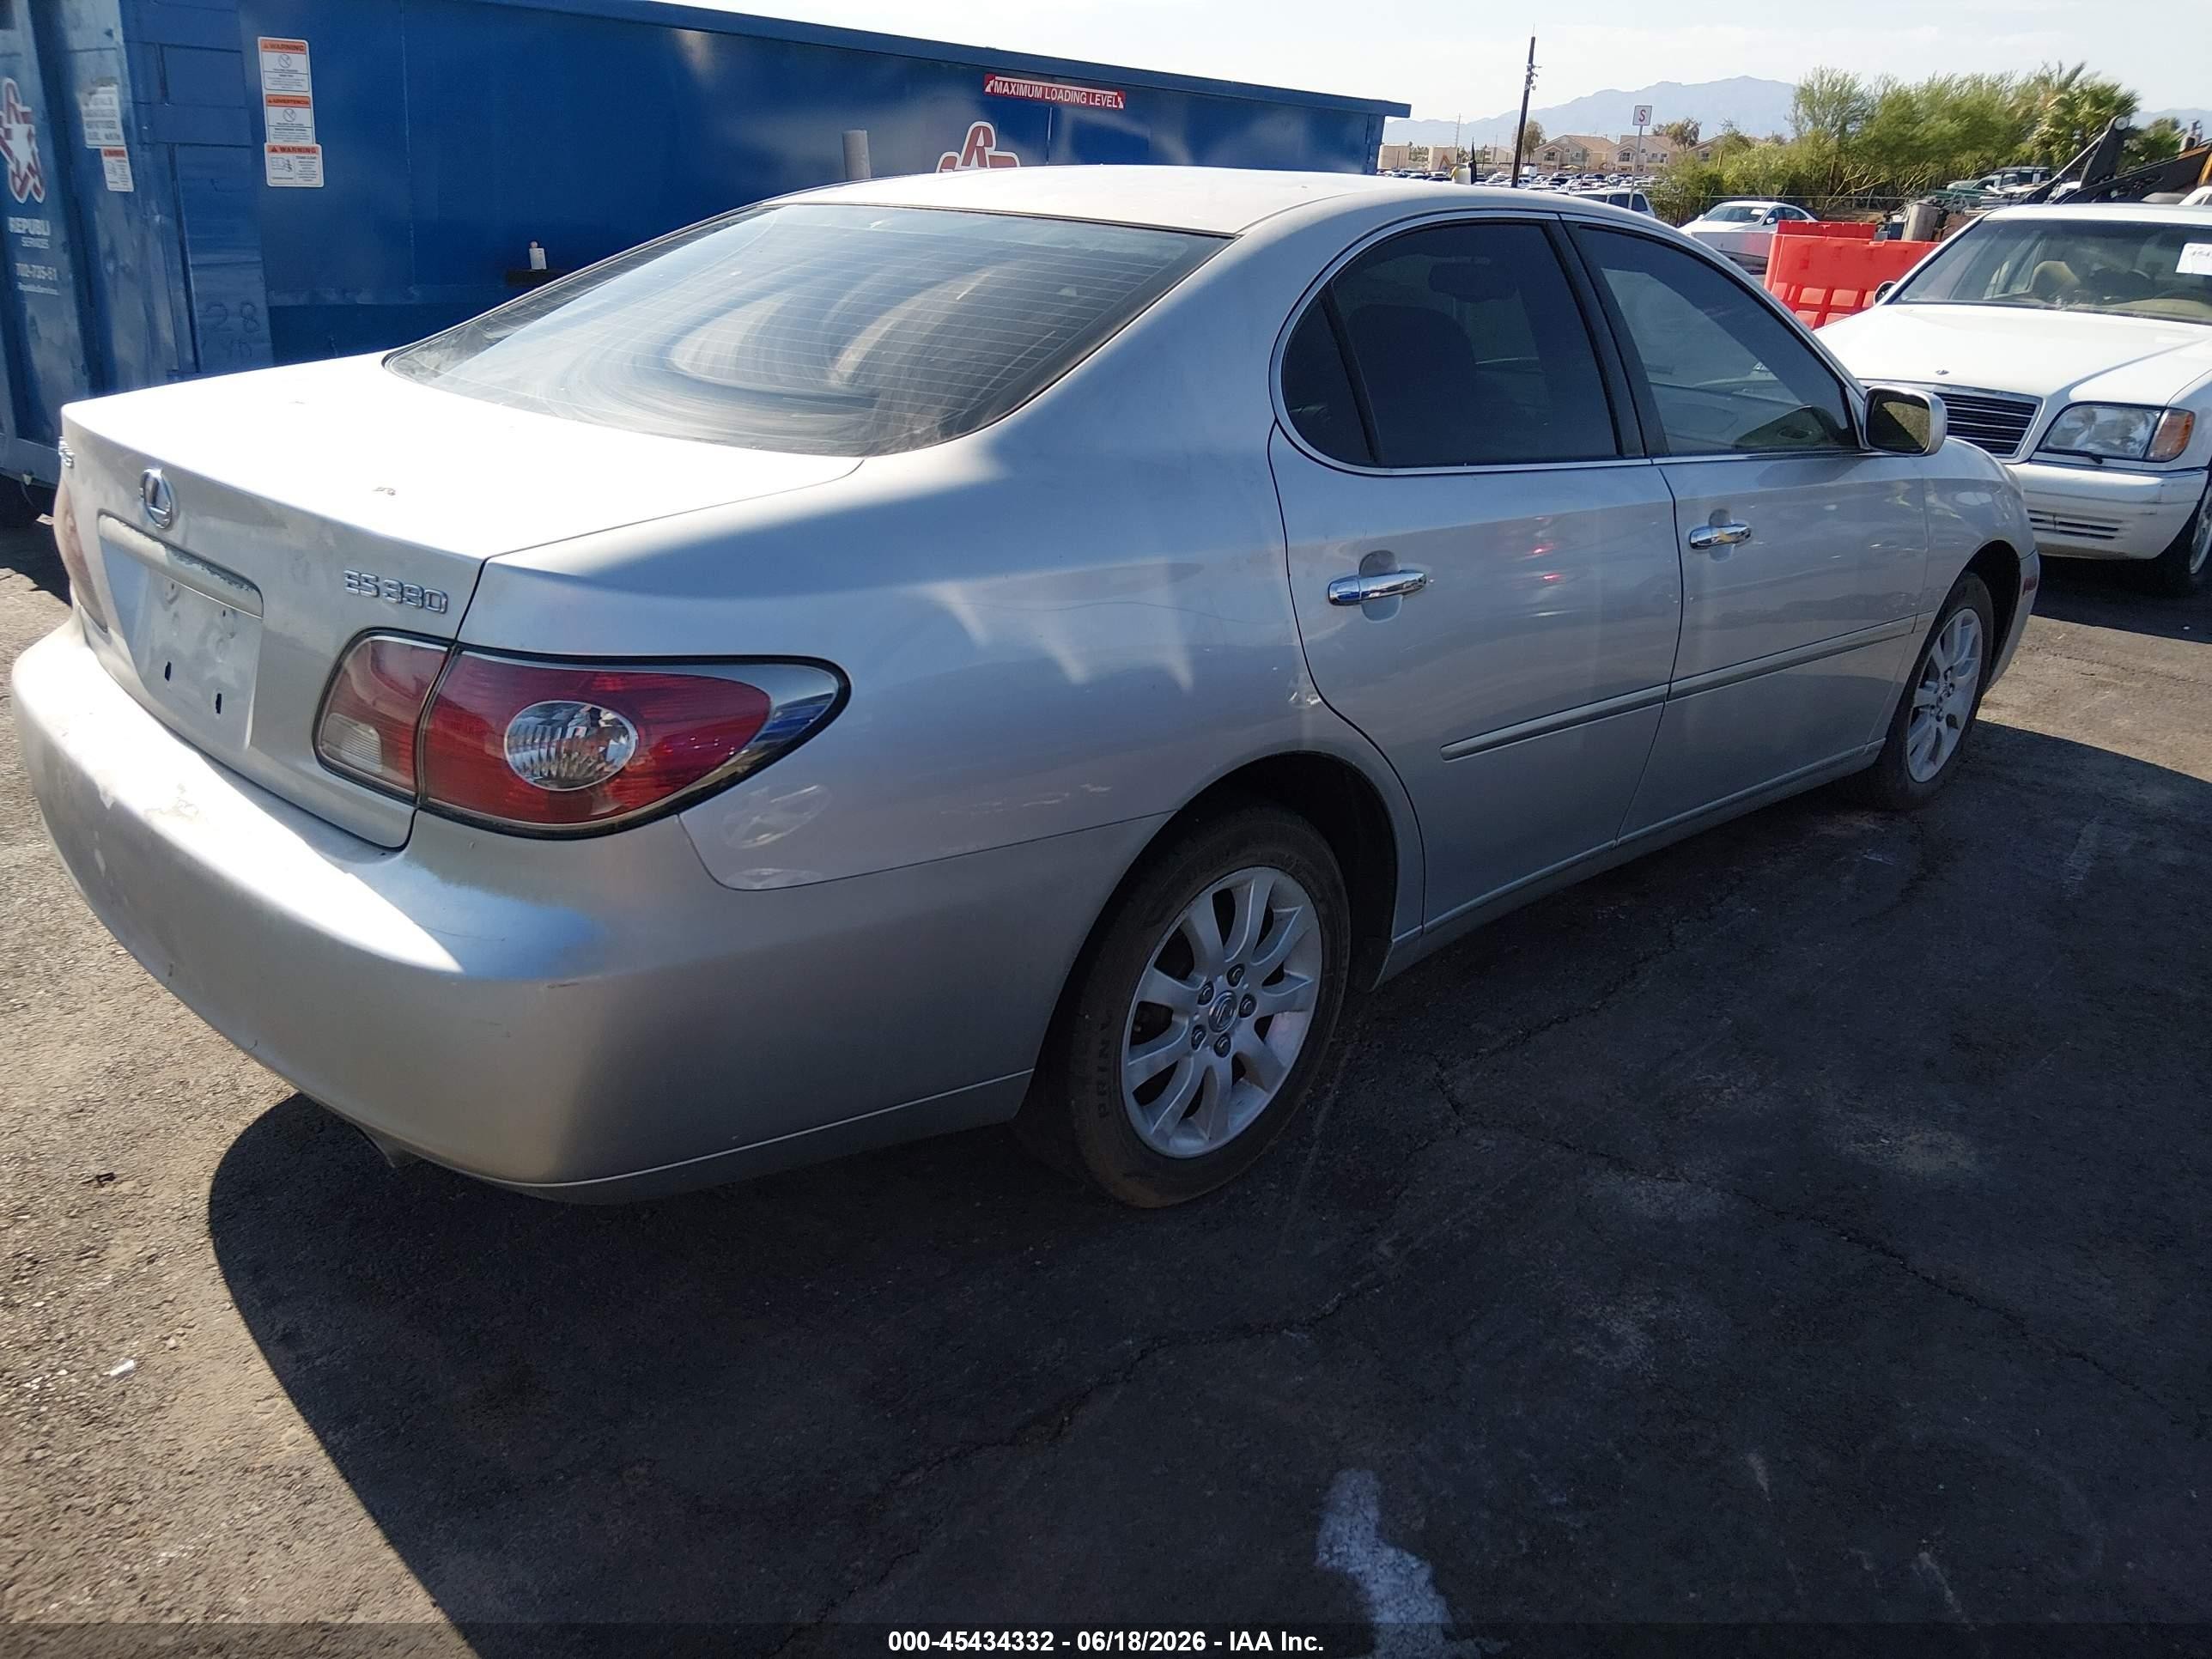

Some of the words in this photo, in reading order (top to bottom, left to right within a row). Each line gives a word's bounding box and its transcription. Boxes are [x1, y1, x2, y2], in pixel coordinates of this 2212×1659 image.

[994, 80, 1042, 99] MAXIMUM
[1044, 87, 1087, 104] LOADING
[1089, 93, 1118, 108] LEVEL
[1638, 109, 1647, 122] S
[343, 569, 380, 598] ES
[382, 579, 448, 614] 330
